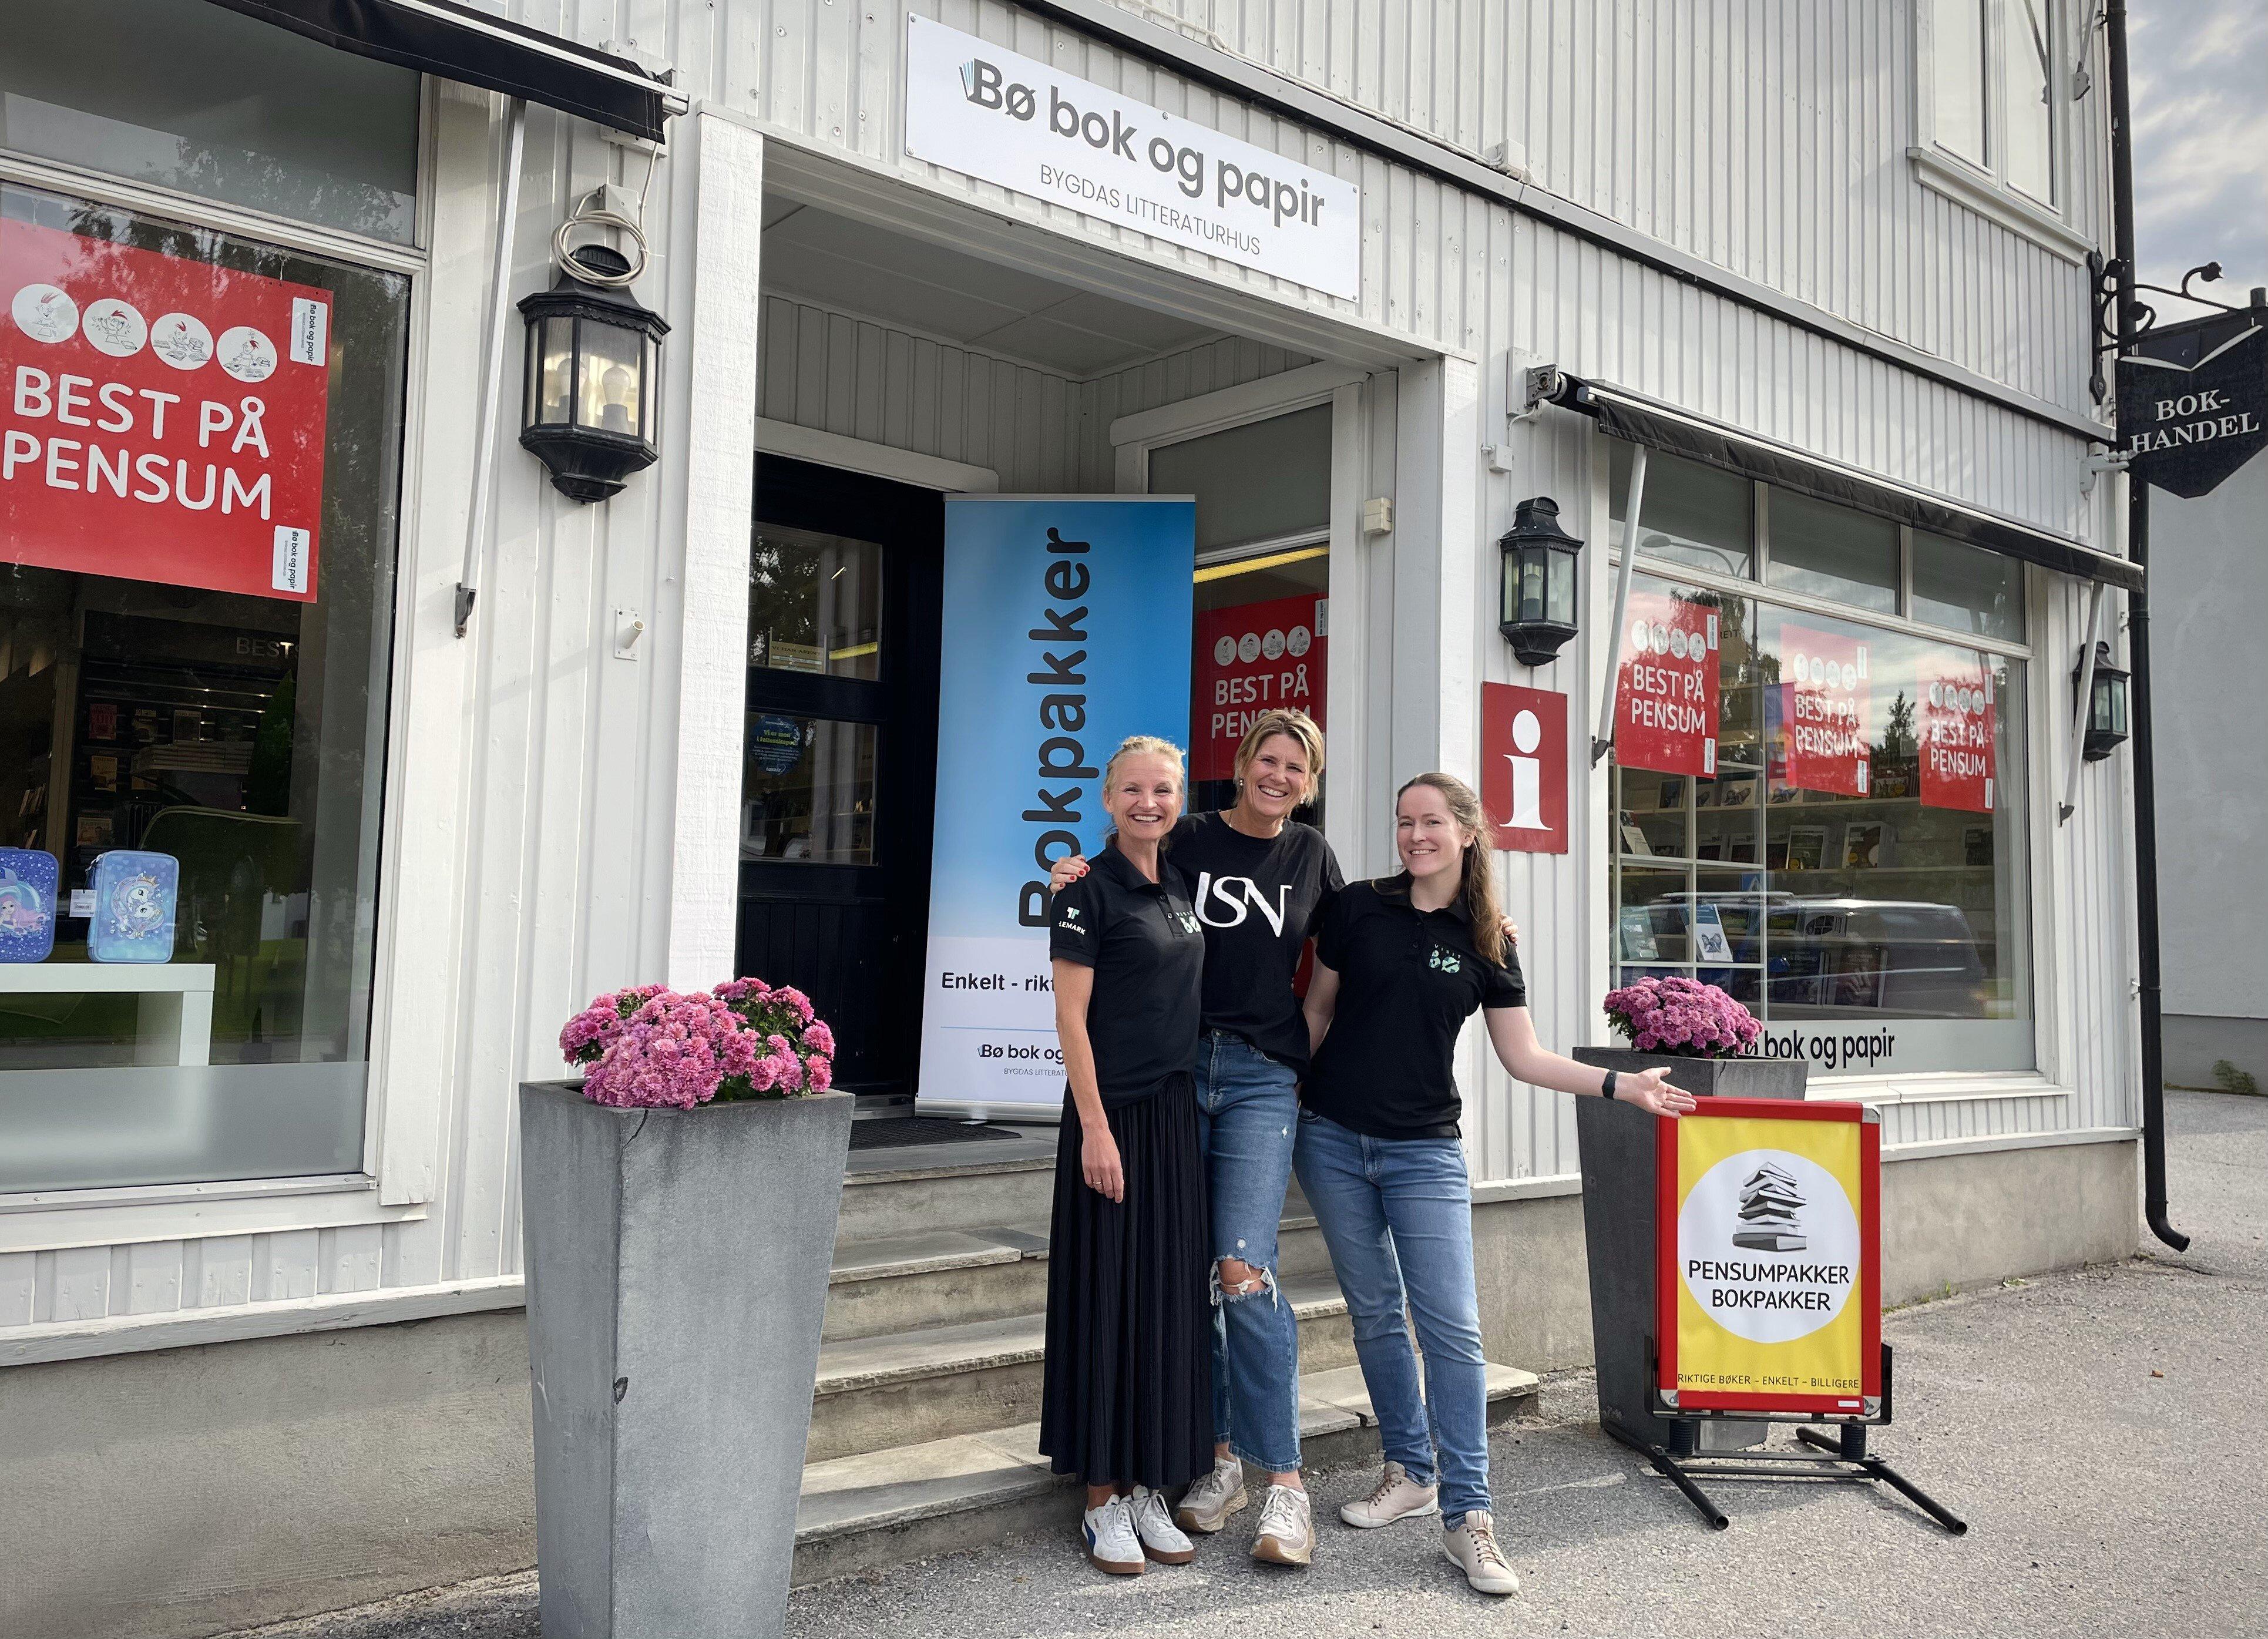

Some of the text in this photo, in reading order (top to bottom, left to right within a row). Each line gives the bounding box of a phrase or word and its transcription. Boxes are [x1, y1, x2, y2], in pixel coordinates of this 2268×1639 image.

[968, 58, 1325, 227] Bø bok og papir
[1040, 164, 1261, 255] BYGDAS LITTERATURHUS
[306, 341, 315, 361] papir
[307, 331, 314, 340] og
[14, 366, 270, 458] BEST PÅ
[2155, 389, 2230, 422] BOK-
[2130, 412, 2260, 455] HANDEL
[2, 430, 271, 520] PENSUM
[288, 569, 297, 589] papir
[289, 558, 296, 567] og
[1215, 663, 1309, 705] BEST PÅ
[1634, 664, 1705, 702] BEST PÅ
[1018, 526, 1098, 928] Bokpakker
[1211, 705, 1311, 739] PEN
[1631, 698, 1705, 735] PENSUM
[1796, 694, 1856, 727] BEST PÅ
[1796, 725, 1858, 758] PENSUM
[1931, 720, 1985, 749] BEST PÅ
[1931, 748, 1985, 777] PENSUM
[1195, 871, 1292, 937] USN
[942, 972, 1005, 990] Enkelt
[980, 1044, 1064, 1064] Bø bok og
[1765, 1029, 1805, 1060] bok
[1810, 1036, 1837, 1069] og
[1843, 1026, 1895, 1068] papir
[1689, 1260, 1850, 1284] PENSUMPAKKER
[1712, 1289, 1831, 1311] BOKPAKKER
[1678, 1373, 1715, 1384] RIKTIGE
[1719, 1373, 1751, 1385] BØKER
[1762, 1376, 1800, 1387] ENKELT
[1811, 1378, 1859, 1389] BILLIGERE
